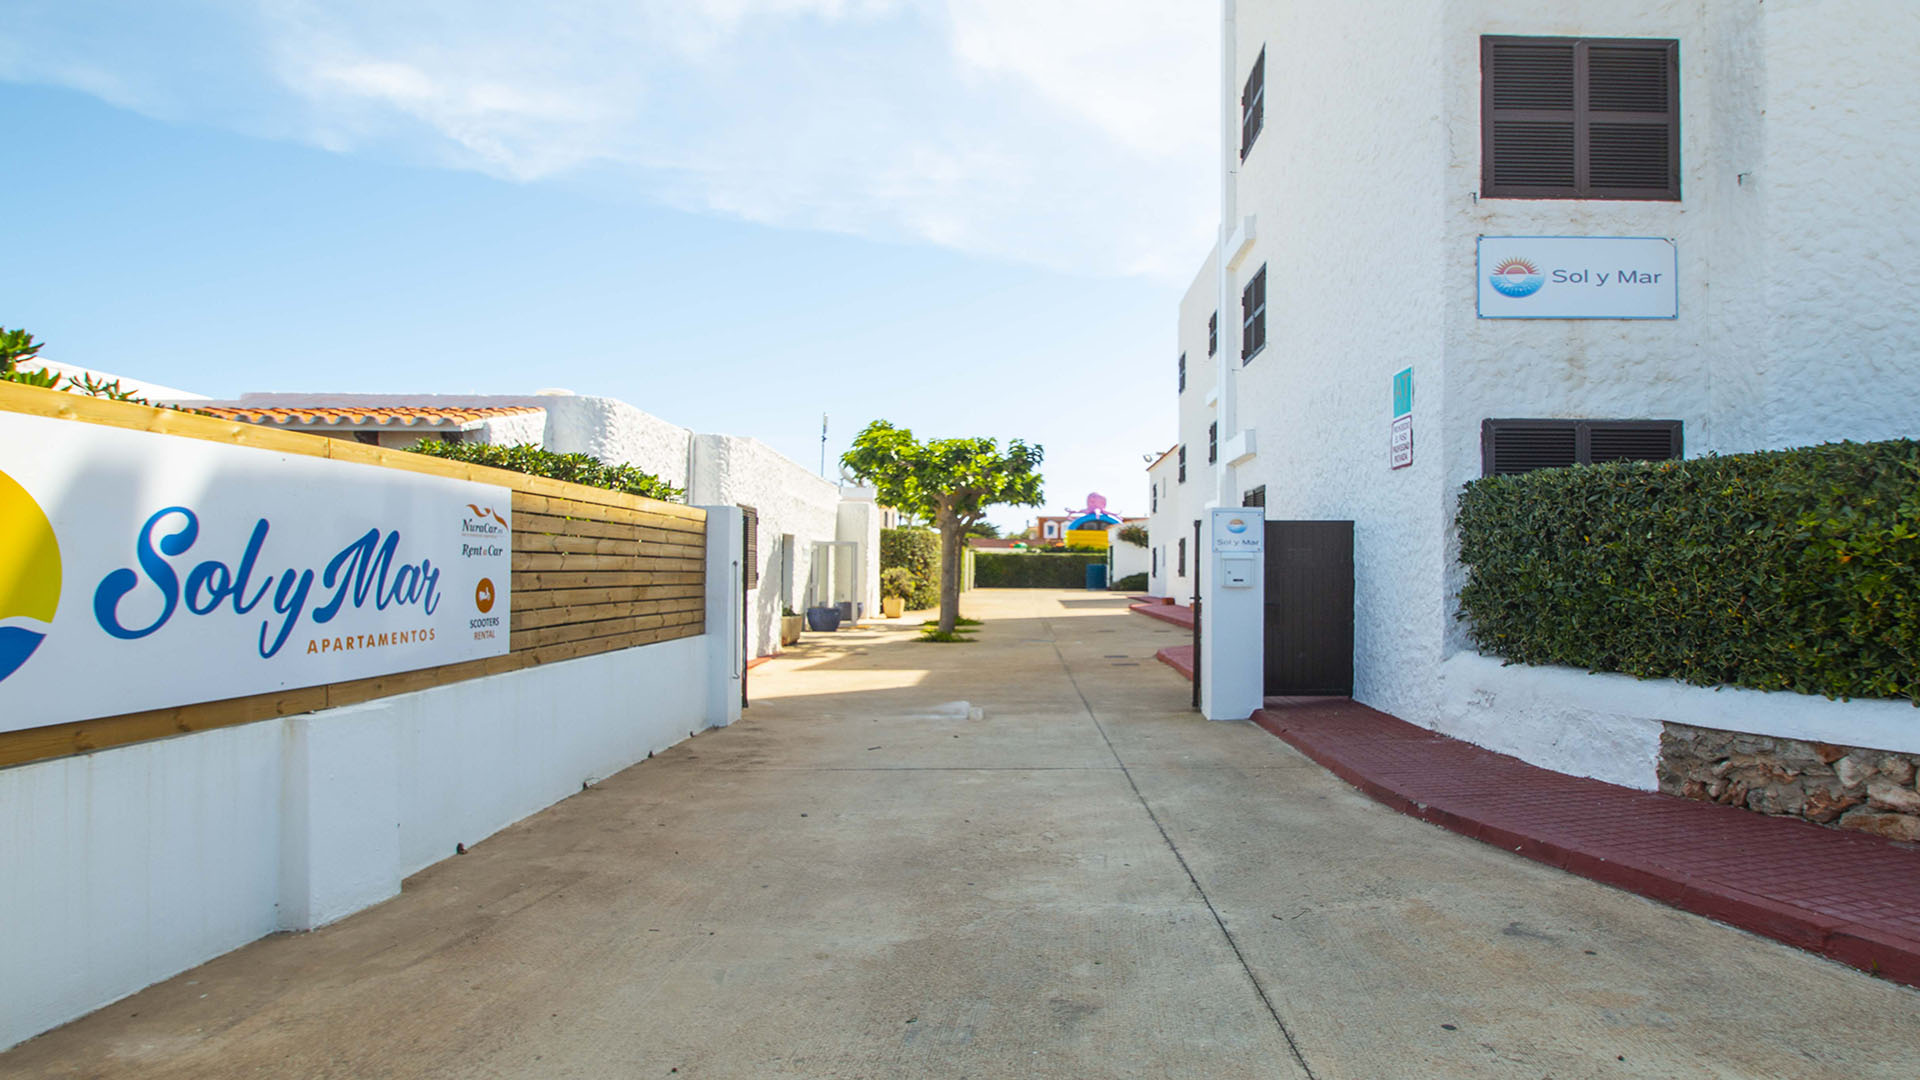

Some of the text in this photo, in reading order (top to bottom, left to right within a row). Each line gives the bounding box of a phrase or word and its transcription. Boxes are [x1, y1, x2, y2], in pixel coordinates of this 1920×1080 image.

[1552, 269, 1662, 287] Sol y Mar
[462, 543, 482, 557] Rent
[488, 544, 503, 556] Car
[93, 506, 441, 659] Sol y Mar
[470, 617, 500, 629] SCOOTERS
[307, 629, 437, 655] APARTAMENTOS
[474, 630, 495, 641] RENTAL
